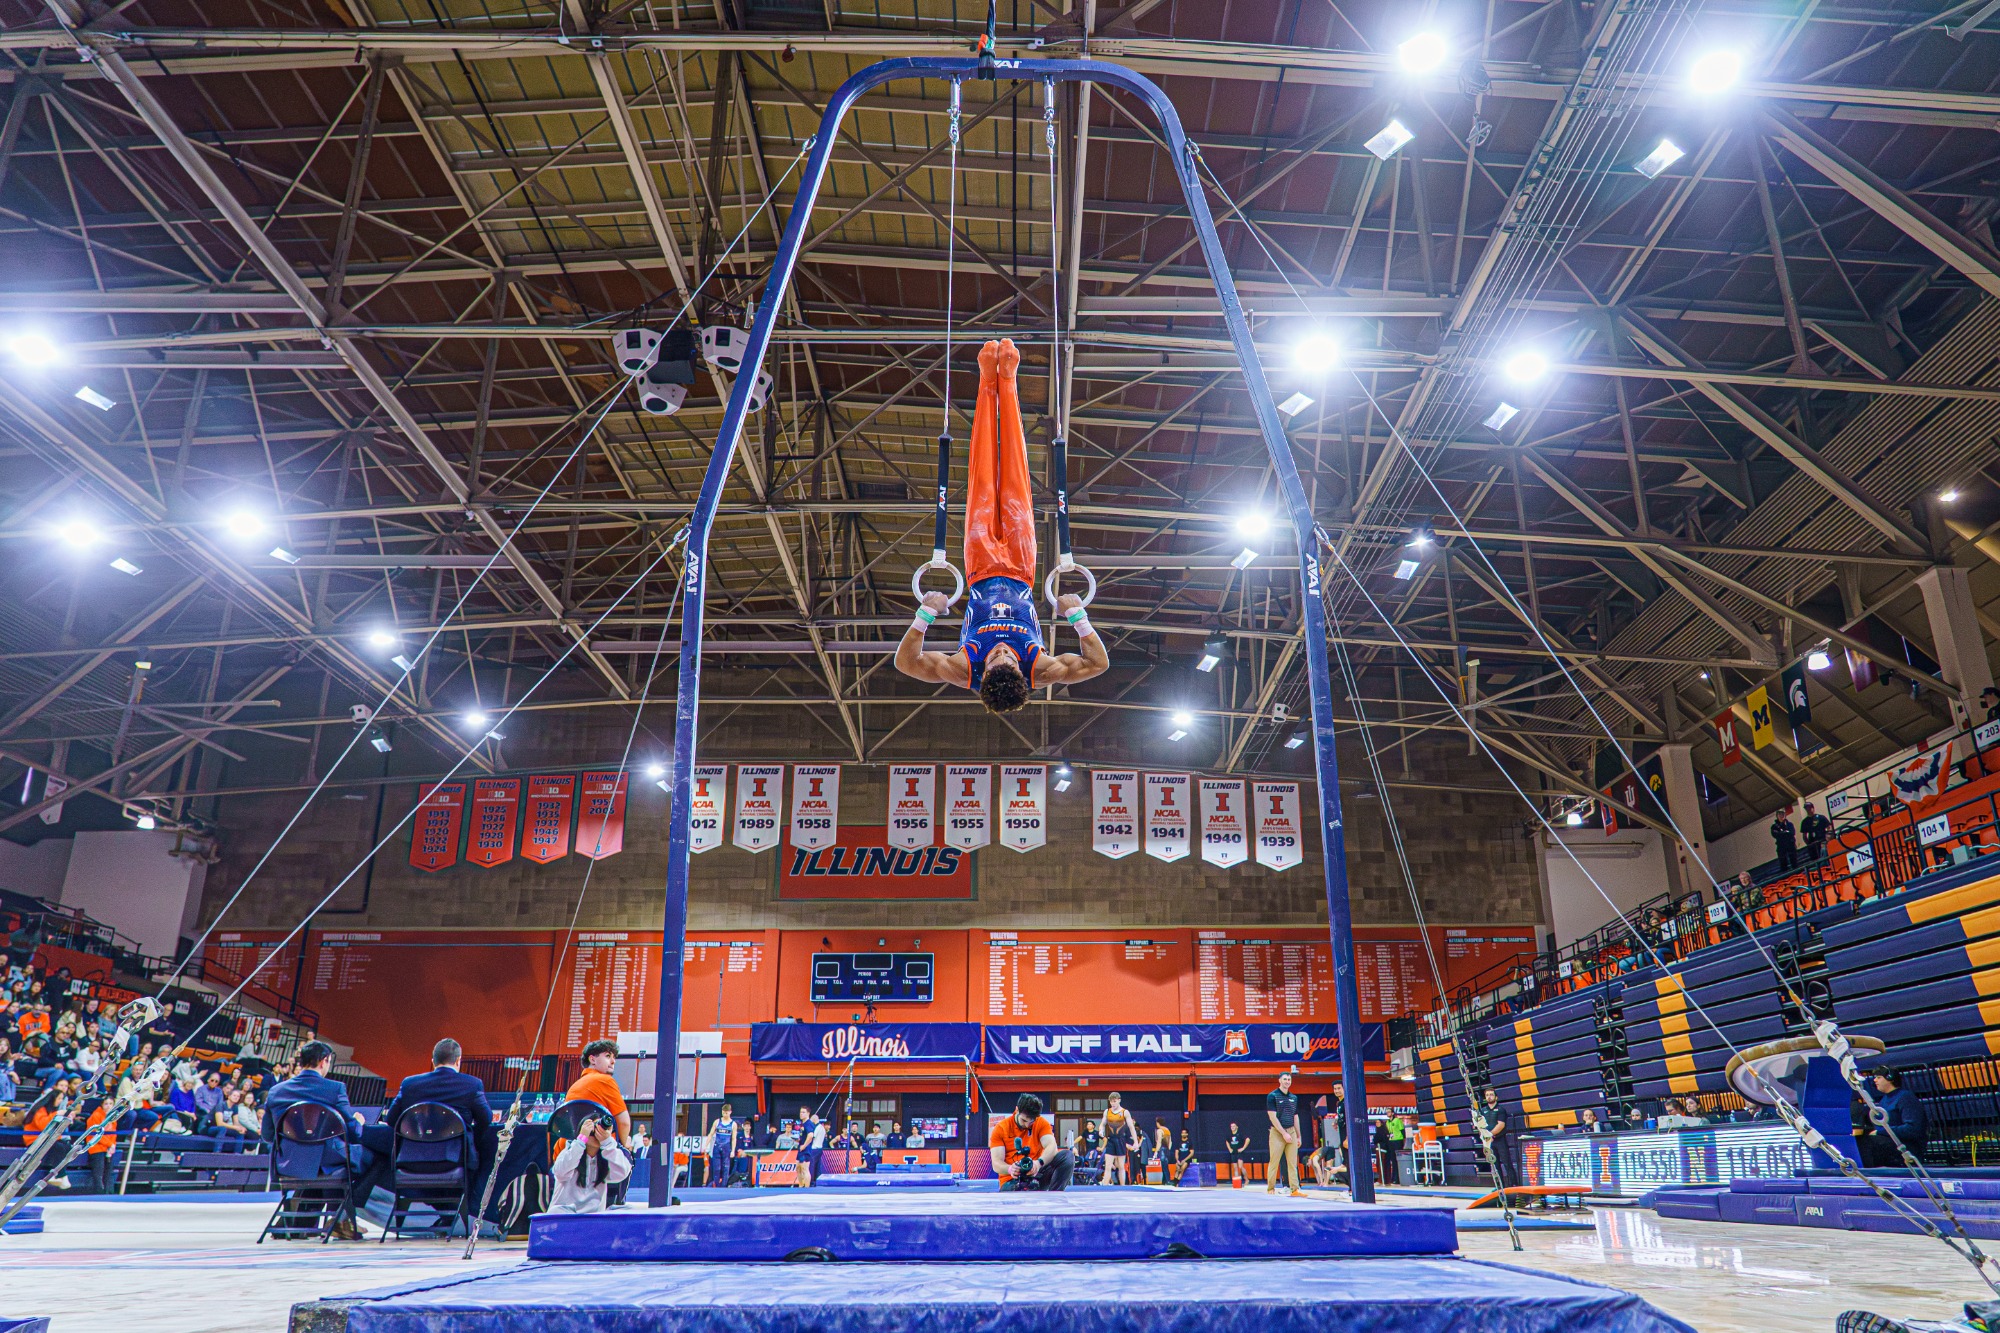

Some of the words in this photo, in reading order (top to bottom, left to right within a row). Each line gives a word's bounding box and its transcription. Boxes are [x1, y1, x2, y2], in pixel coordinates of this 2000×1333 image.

[977, 623, 1028, 634] ILLINOIS
[1984, 725, 2000, 738] 203
[741, 767, 780, 775] ILLINOIS
[797, 767, 837, 775] ILLINOIS
[893, 767, 932, 775] ILLINOIS
[949, 767, 988, 775] ILLINOIS
[1004, 767, 1043, 775] ILLINOIS
[533, 777, 571, 785] ILLINOIS
[1095, 773, 1135, 781] ILLINOIS
[1148, 776, 1187, 784] ILLINOIS
[1203, 782, 1241, 790] ILLINOIS
[1256, 785, 1296, 793] ILLINOIS
[538, 802, 561, 810] 1932
[744, 800, 772, 808] NCAA
[801, 800, 828, 808] NCAA
[897, 800, 925, 808] NCAA
[954, 800, 981, 808] NCAA
[1009, 800, 1037, 808] NCAA
[1829, 798, 1841, 809] 203
[1101, 806, 1128, 814] NCAA
[1153, 809, 1181, 818] NCAA
[482, 814, 506, 822] 1926
[1208, 815, 1237, 823] NCAA
[1263, 817, 1292, 827] NCAA
[691, 819, 717, 829] 012
[739, 819, 775, 829] 1989
[797, 819, 831, 829] 1958
[894, 819, 928, 829] 1956
[951, 819, 984, 829] 1955
[1005, 819, 1040, 829] 1950
[534, 828, 559, 836] 1946
[1097, 824, 1133, 835] 1942
[1151, 827, 1185, 838] 1941
[1921, 823, 1938, 838] 104
[424, 836, 448, 844] 1922
[1205, 833, 1242, 844] 1940
[1260, 836, 1296, 847] 1939
[478, 840, 503, 848] 1930
[422, 845, 447, 853] 1924
[789, 846, 963, 877] ILLINOIS
[1710, 907, 1720, 917] 103
[821, 1025, 910, 1059] Illinois
[1010, 1034, 1102, 1054] HUFF
[1110, 1034, 1202, 1053] HALL
[1271, 1031, 1310, 1054] 100
[759, 1163, 797, 1172] ILLINOI
